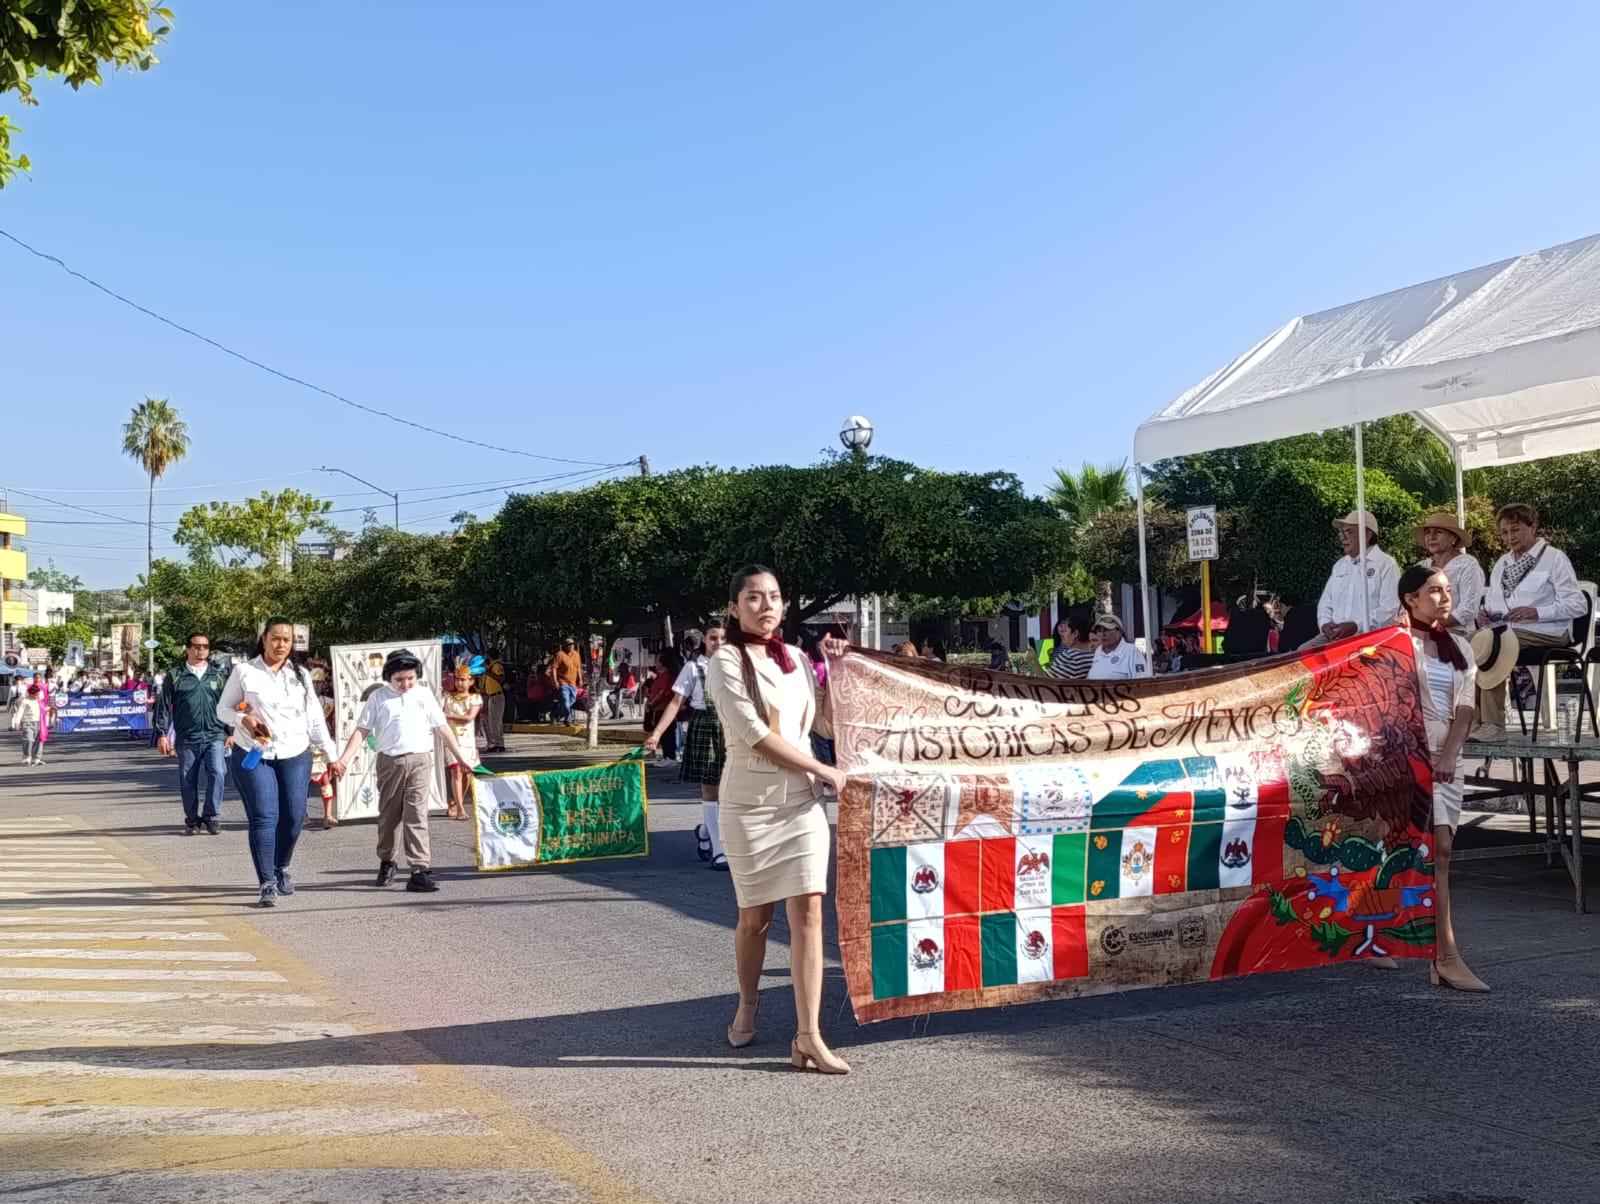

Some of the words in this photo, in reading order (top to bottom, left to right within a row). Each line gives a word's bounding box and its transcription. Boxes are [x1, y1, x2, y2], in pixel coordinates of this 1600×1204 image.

[1189, 512, 1214, 528] EXCLUSIVO
[1192, 537, 1213, 547] TAXIS
[944, 667, 1141, 719] BANDERAS
[1102, 715, 1148, 752] DE
[561, 777, 623, 796] COLEGIO
[566, 806, 622, 826] REAL
